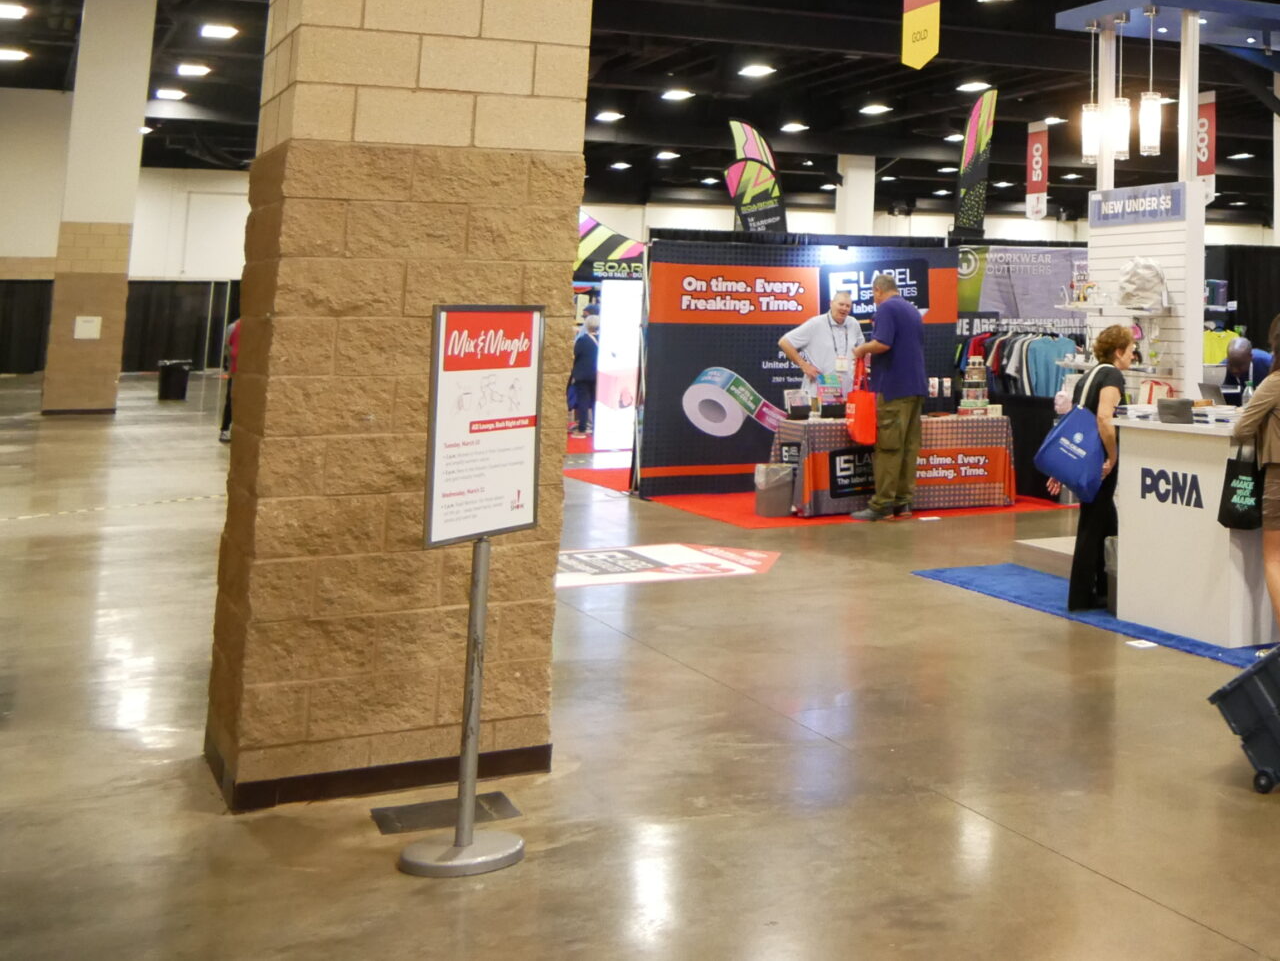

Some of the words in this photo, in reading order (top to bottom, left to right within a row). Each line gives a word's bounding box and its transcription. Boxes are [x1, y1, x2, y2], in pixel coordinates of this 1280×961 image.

[911, 29, 928, 43] GOLD
[1197, 118, 1209, 162] 600
[1032, 143, 1043, 182] 500
[1101, 200, 1124, 214] NEW
[1125, 197, 1158, 213] UNDER
[1160, 195, 1172, 210] $5
[985, 253, 1052, 263] WORKWEAR
[986, 265, 1052, 275] OUTFITTERS
[682, 277, 707, 292] On
[710, 277, 752, 293] time.
[755, 278, 805, 296] Every.
[681, 295, 755, 314] Freaking.
[759, 296, 803, 312] Time.
[448, 329, 476, 357] Mix
[484, 329, 530, 366] Mingle
[929, 455, 955, 465] time.
[957, 455, 988, 466] Every.
[916, 467, 957, 478] reaking.
[960, 466, 988, 476] Time.
[1141, 467, 1204, 509] PCNA
[1231, 494, 1256, 506] MARK
